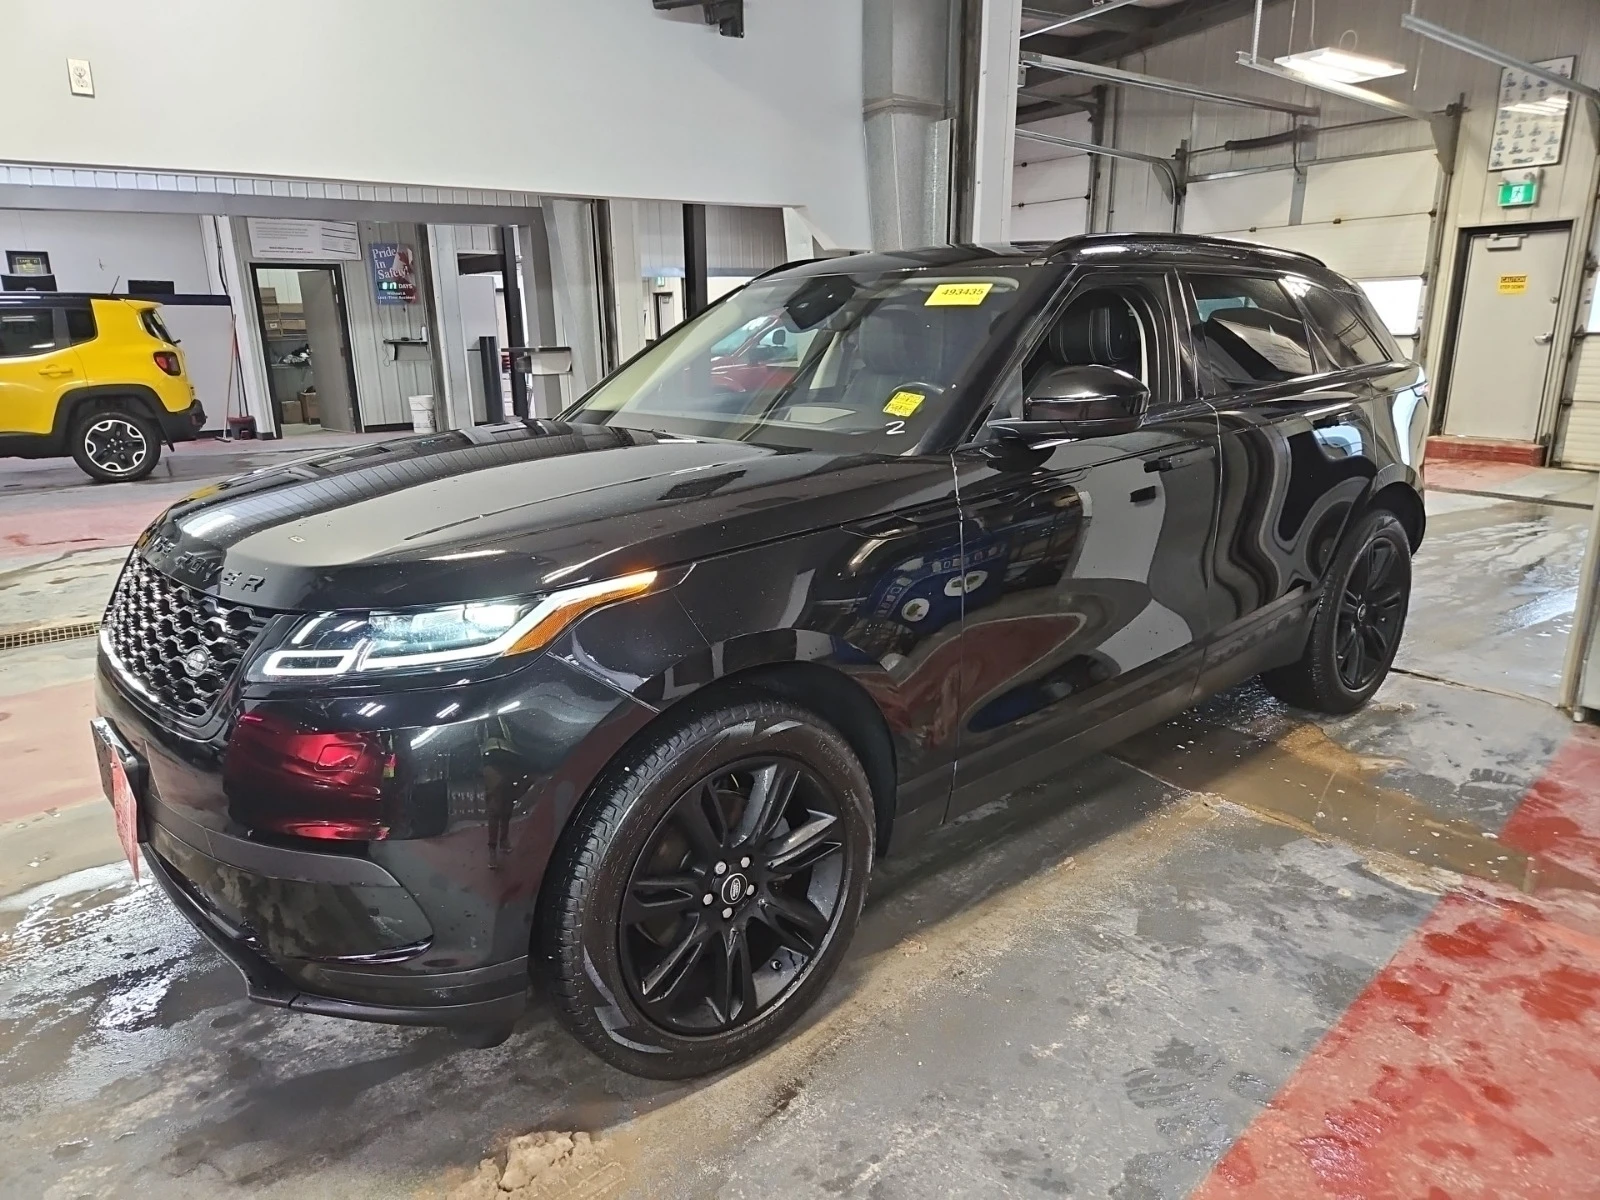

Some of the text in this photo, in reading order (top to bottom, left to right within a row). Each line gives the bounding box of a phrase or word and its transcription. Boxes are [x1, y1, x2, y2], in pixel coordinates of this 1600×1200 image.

[372, 247, 397, 259] Pride
[377, 266, 410, 280] Safety!
[941, 288, 984, 296] 493435
[885, 420, 906, 435] 2
